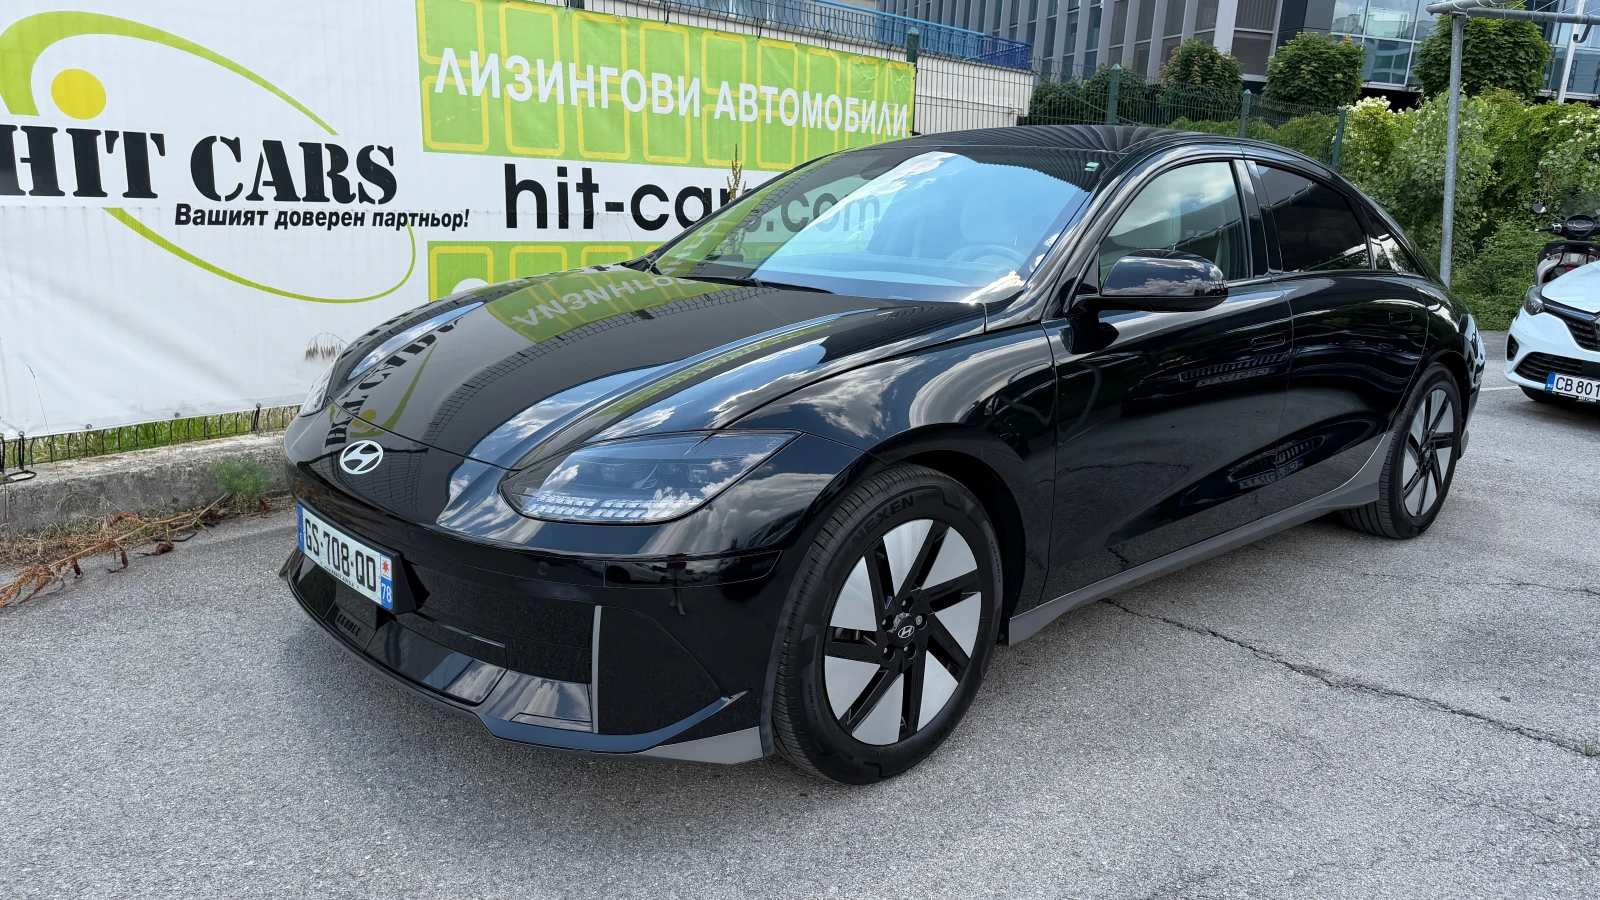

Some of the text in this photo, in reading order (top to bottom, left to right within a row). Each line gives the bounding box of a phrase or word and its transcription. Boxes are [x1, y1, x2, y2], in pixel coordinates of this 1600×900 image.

[434, 47, 909, 138] ЛИЗИНГОВИ АВТОМОБИЛИ
[0, 124, 398, 205] HIT CARS
[174, 203, 470, 232] Вашият доверен партньор!
[1556, 377, 1573, 391] CB
[851, 494, 915, 547] NEXEN
[381, 583, 392, 603] 78
